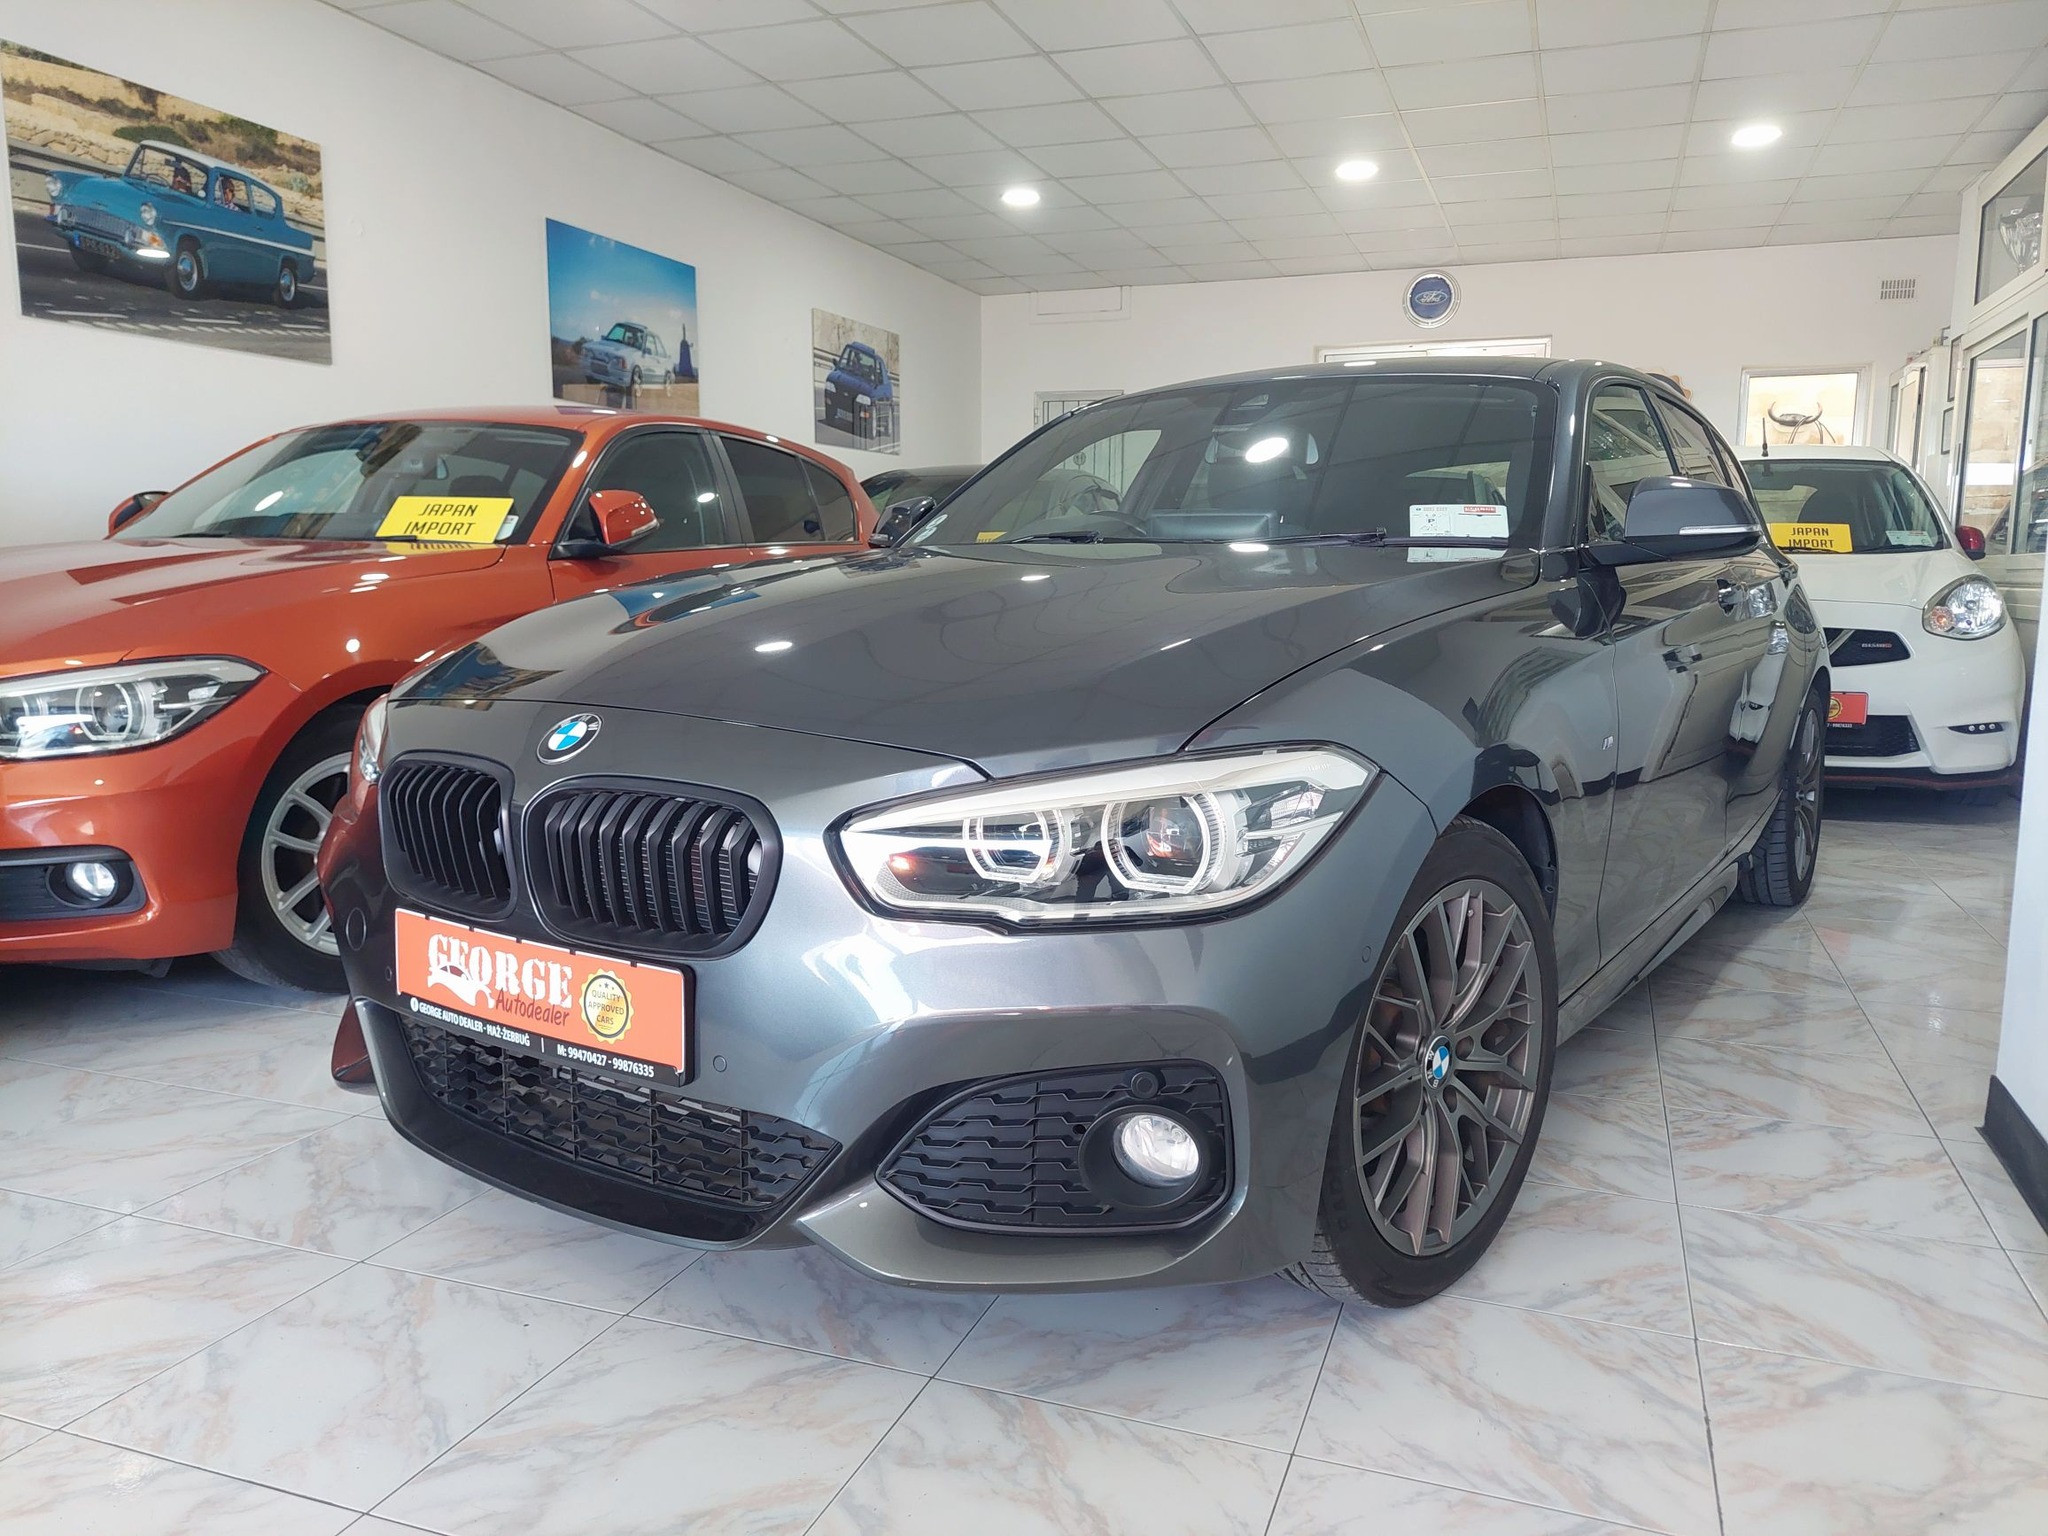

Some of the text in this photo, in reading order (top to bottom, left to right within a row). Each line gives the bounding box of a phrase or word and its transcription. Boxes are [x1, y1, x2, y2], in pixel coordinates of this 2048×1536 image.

[418, 503, 479, 517] JAPAN
[403, 521, 476, 535] IMPORT
[1791, 527, 1829, 536] JAPAN
[1788, 538, 1835, 549] IMPORT
[427, 933, 573, 1009] GEORGE
[591, 989, 621, 1003] QUALITY
[495, 987, 570, 1026] Autodealer
[587, 1000, 625, 1015] APPROVED
[419, 1001, 443, 1020] GEORGE
[442, 1010, 459, 1026] AUTO
[459, 1015, 484, 1033] DEALER
[596, 1014, 614, 1026] CARS
[556, 1043, 567, 1057] M:
[567, 1046, 608, 1067] 99470427
[612, 1057, 655, 1078] 99876335
